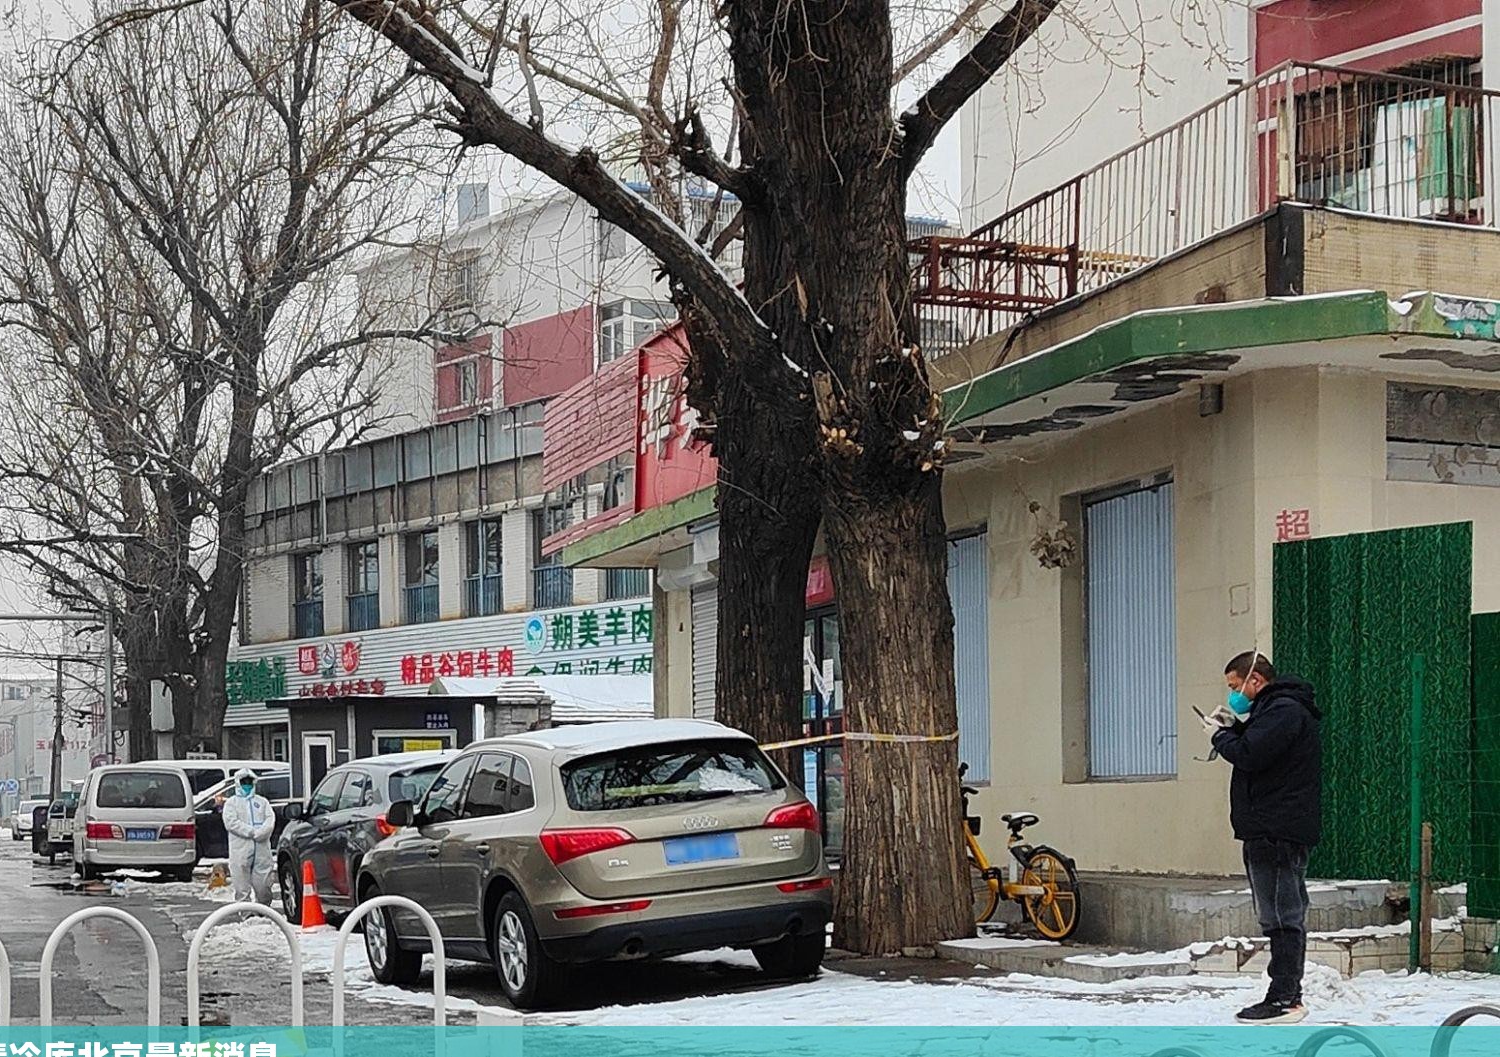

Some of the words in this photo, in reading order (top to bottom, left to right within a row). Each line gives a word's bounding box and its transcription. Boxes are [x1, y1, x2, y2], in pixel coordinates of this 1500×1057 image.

[1276, 509, 1309, 541] 超
[551, 604, 653, 651] 朔美羊肉
